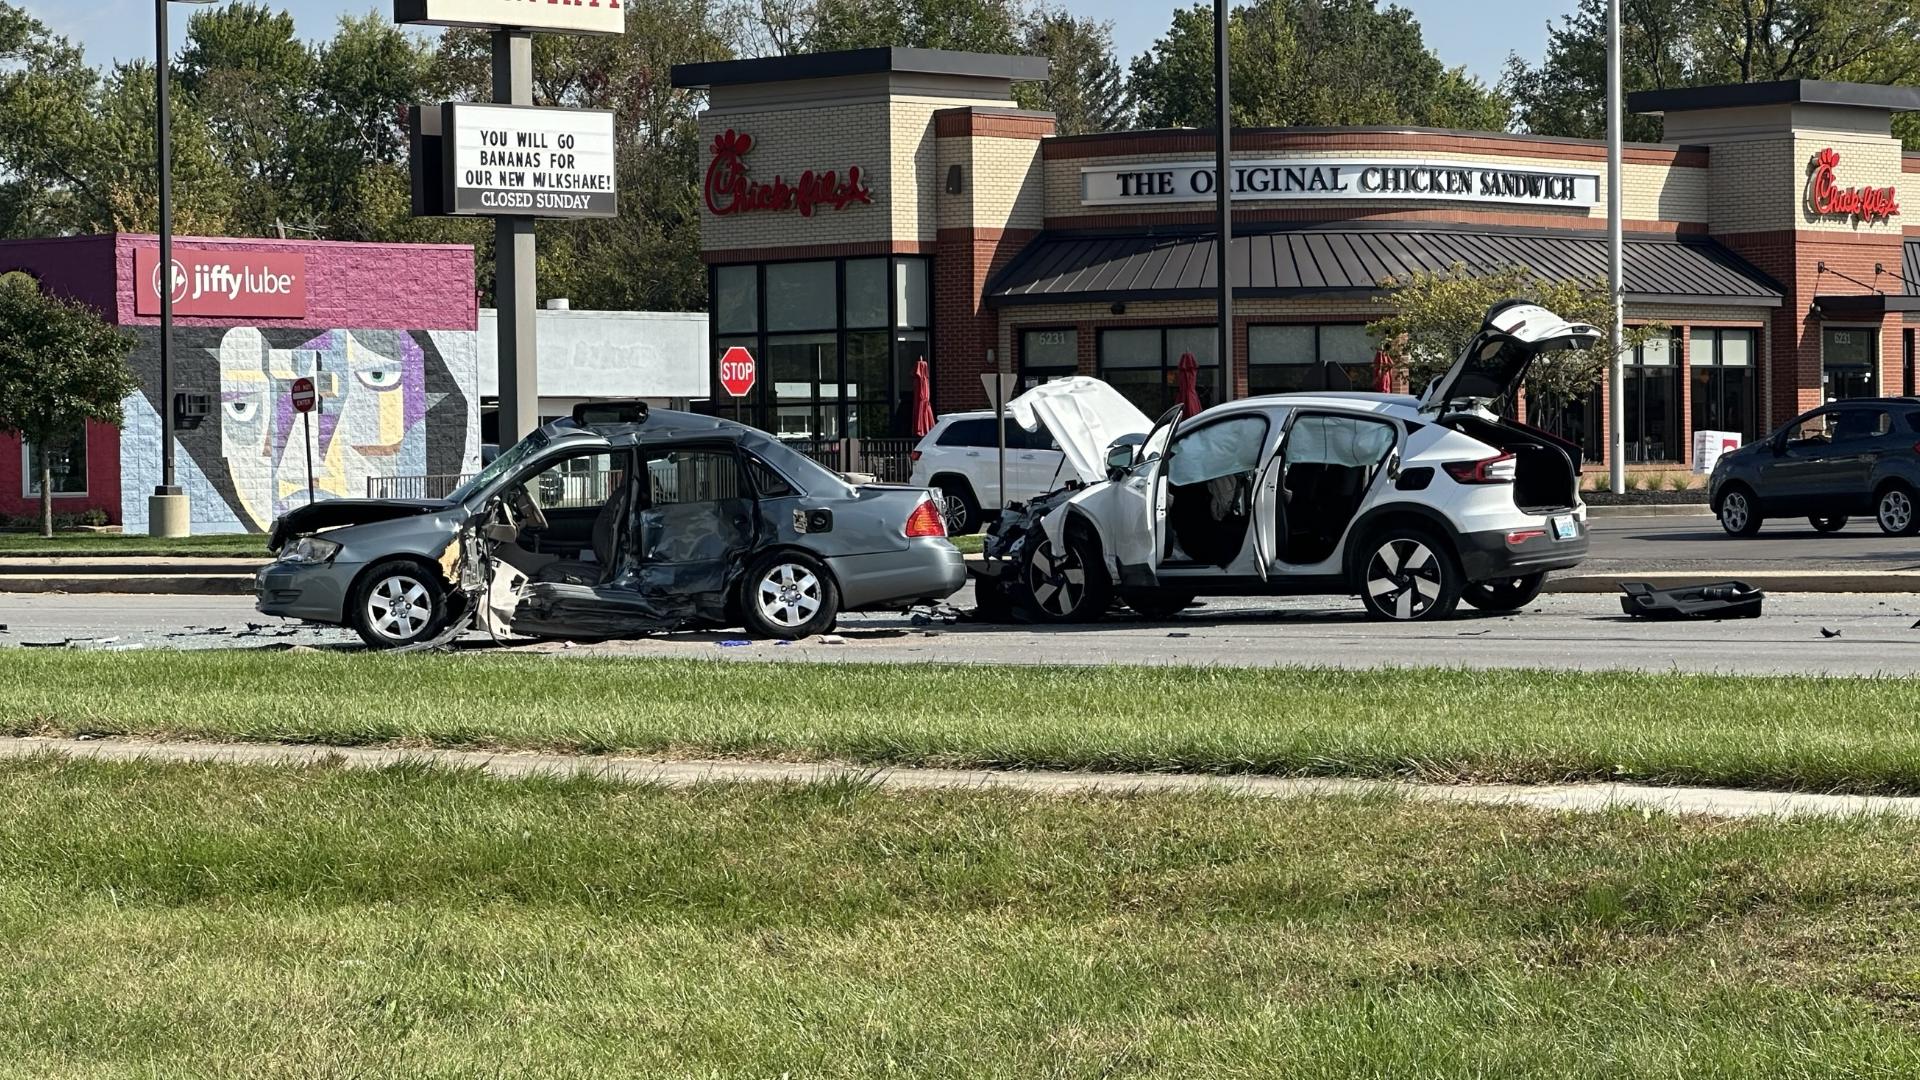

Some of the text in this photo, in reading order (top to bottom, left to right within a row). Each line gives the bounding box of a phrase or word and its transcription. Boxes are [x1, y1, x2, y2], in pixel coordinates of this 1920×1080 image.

[480, 130, 575, 149] YOU WILL GO
[480, 150, 575, 169] BANANAS FOR
[465, 170, 611, 190] OUR NEW MILKSHAKE!
[1116, 166, 1577, 200] THE OIGINAL CHICKEN SANDWICH
[481, 191, 591, 209] CLOSED SUNDAY
[722, 362, 753, 381] STOP
